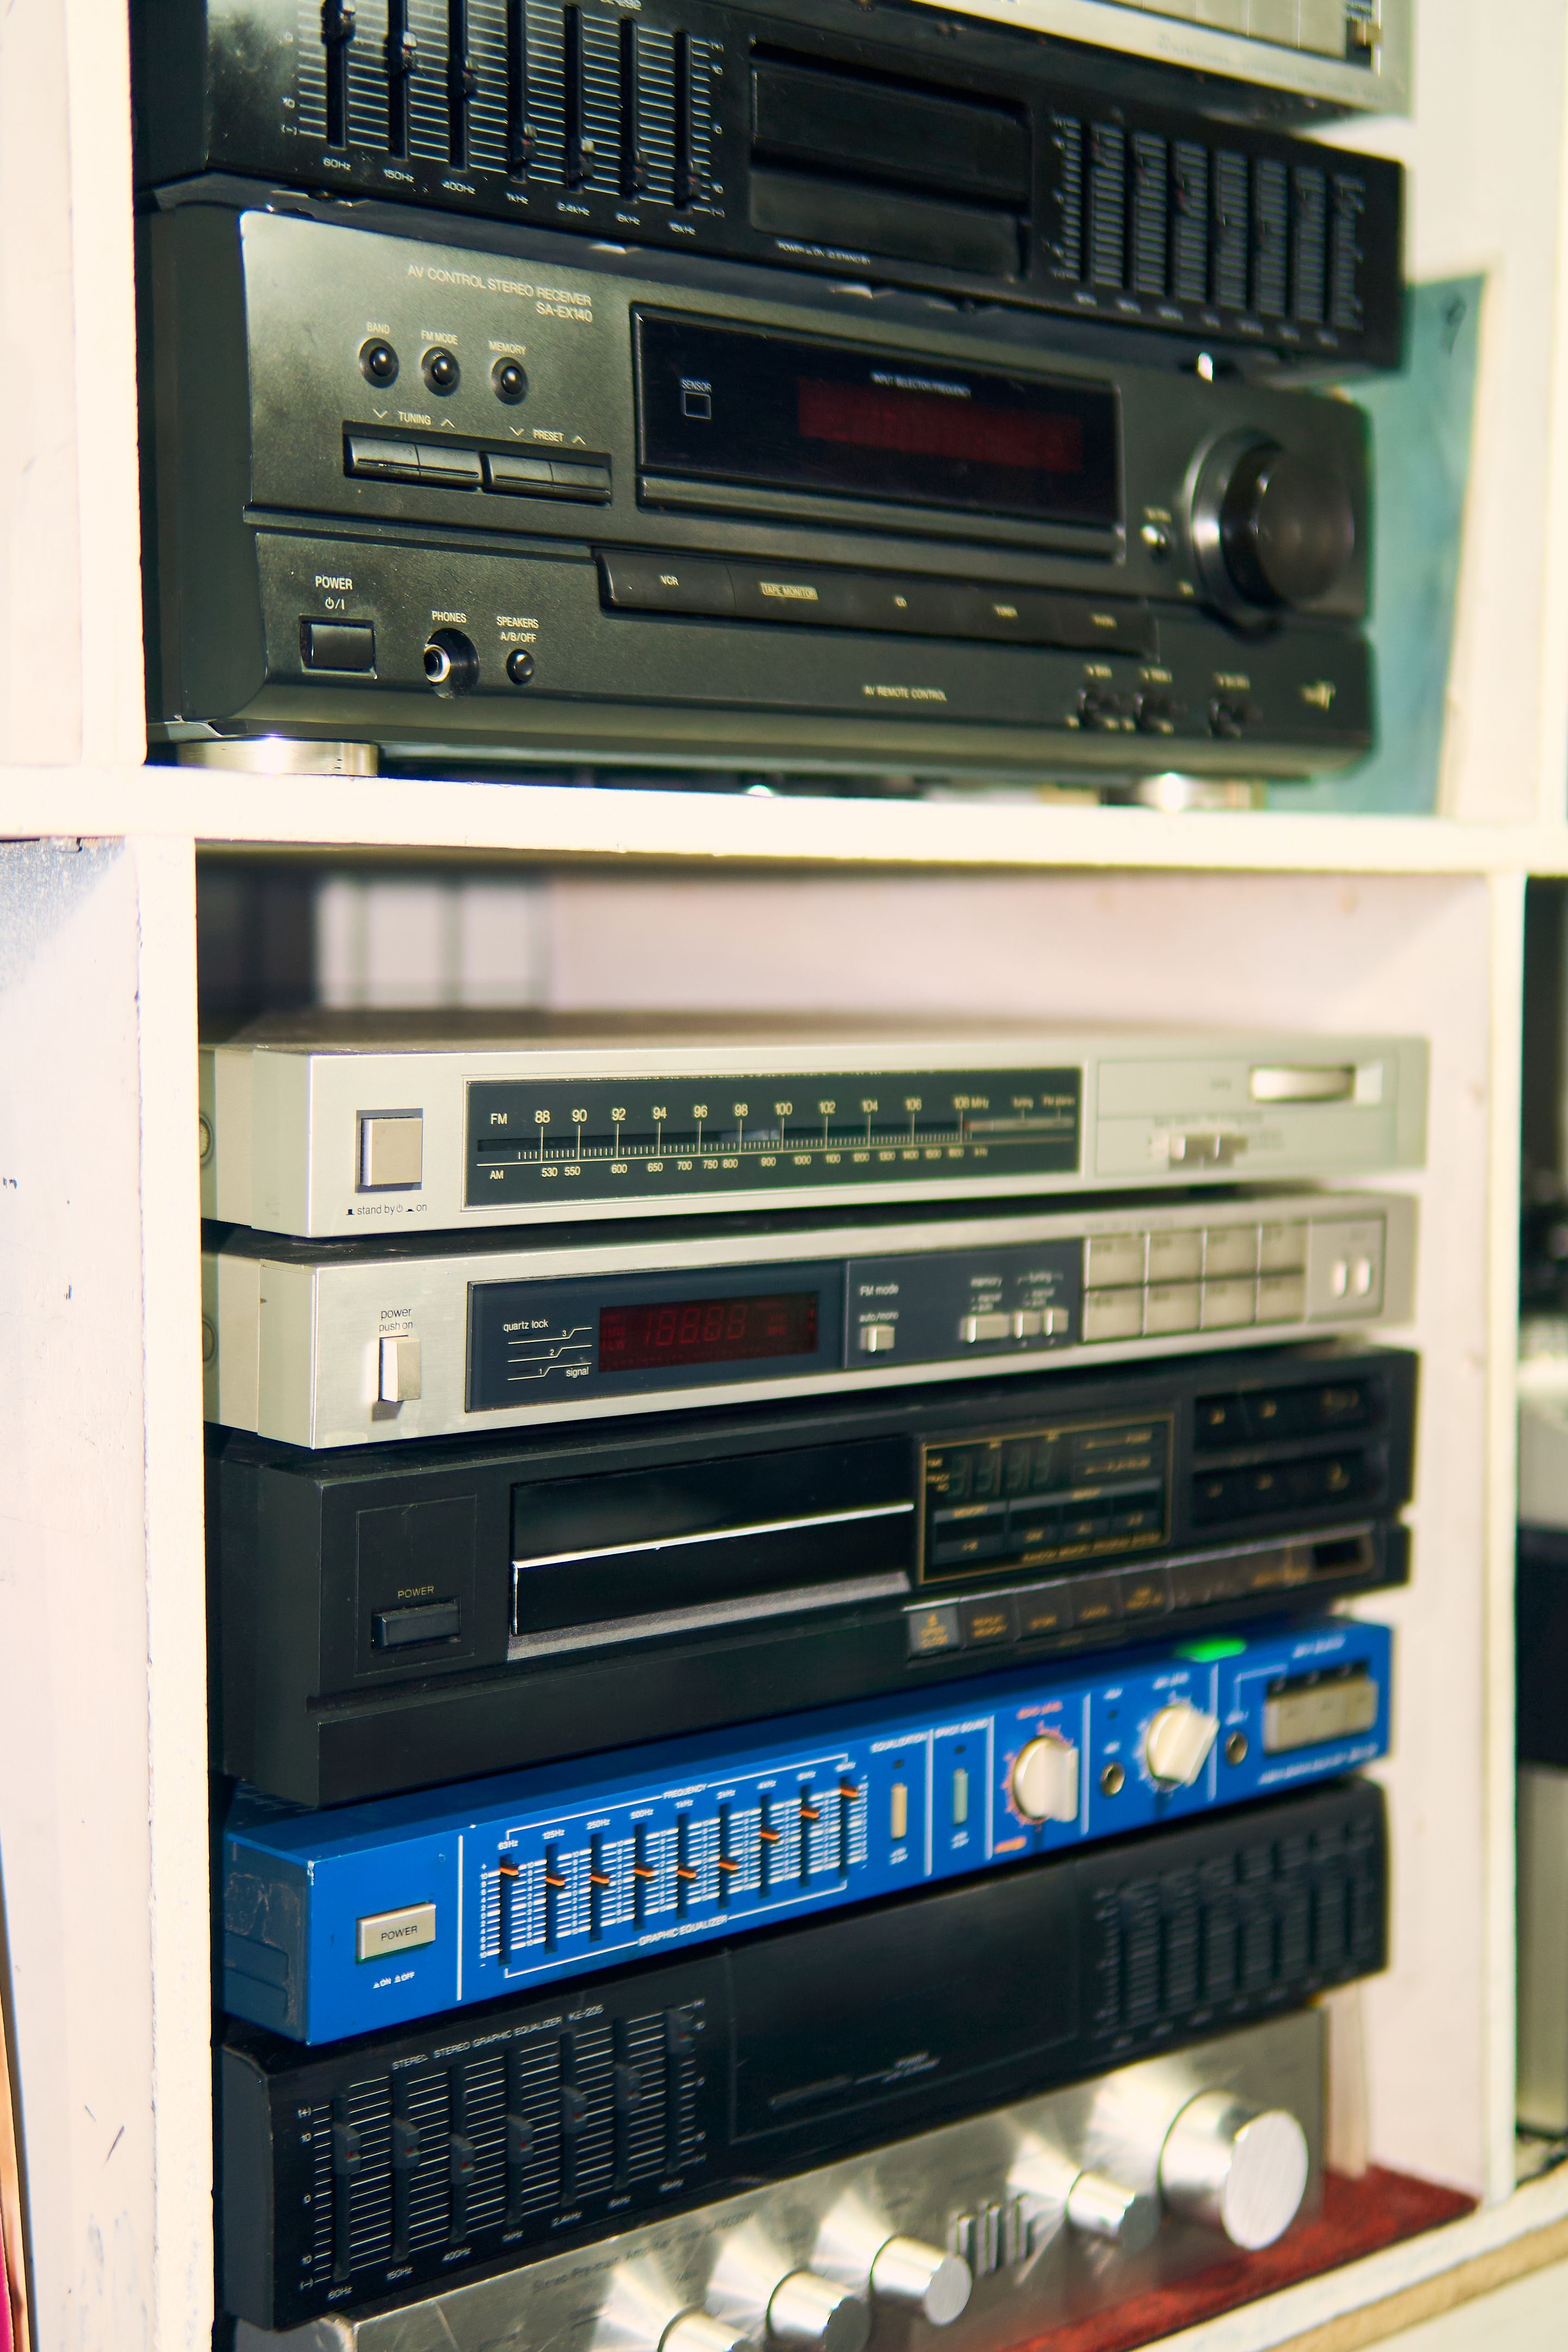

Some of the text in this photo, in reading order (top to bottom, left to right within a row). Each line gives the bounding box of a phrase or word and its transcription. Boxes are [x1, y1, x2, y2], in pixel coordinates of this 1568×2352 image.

[384, 169, 414, 183] 150Hz
[442, 180, 476, 195] 400Hz
[408, 265, 592, 307] AV CONTROL STEREO RECEIVER
[536, 301, 593, 322] SA-EX140
[366, 322, 390, 335] BAND
[421, 330, 458, 345] FM MODE
[488, 340, 526, 355] MEMORY
[680, 377, 713, 394] SENSOR
[398, 411, 431, 426] TUNING
[532, 429, 564, 443] PRESET
[315, 575, 353, 591] POWER
[660, 575, 679, 587] VCR
[432, 610, 467, 624] PHONES
[496, 615, 539, 629] SPEAKERS
[500, 632, 537, 643] A/B/OFF
[491, 1113, 507, 1124] FM
[535, 1110, 550, 1124] 88
[572, 1108, 587, 1123] 90
[611, 1107, 627, 1121] 92
[653, 1106, 667, 1120] 94
[694, 1104, 708, 1118] 96
[734, 1104, 748, 1117] 98
[775, 1102, 793, 1116] 100
[819, 1102, 836, 1115] 102
[862, 1100, 878, 1113] 104
[905, 1099, 922, 1112] 106
[490, 1170, 504, 1180] AM
[542, 1167, 558, 1178] 530
[565, 1166, 581, 1177] 550
[611, 1164, 627, 1174] 600
[647, 1162, 663, 1173] 650
[677, 1160, 693, 1171] 700
[703, 1159, 718, 1169] 750
[722, 1158, 738, 1168] 800
[761, 1156, 776, 1167] 900
[794, 1155, 811, 1165] 1000
[357, 1204, 427, 1217] stand by on
[860, 1284, 899, 1296] FM mode
[381, 1308, 412, 1320] power
[378, 1321, 413, 1333] push on
[503, 1319, 549, 1333] quartz lock
[562, 1330, 567, 1338] 3
[566, 1367, 589, 1378] signal
[397, 1585, 434, 1599] POWER
[662, 1784, 707, 1799] FREQUENCY
[498, 1840, 518, 1850] 63Hz
[542, 1829, 565, 1840] 125Hz
[587, 1819, 610, 1829] 250Hz
[381, 1926, 418, 1940] POWER
[638, 1928, 678, 1946] GRAPHIC
[434, 2041, 470, 2058] STEREO
[473, 2030, 513, 2048] GRAPHIC
[513, 2016, 562, 2036] EQUALIZER
[300, 2132, 312, 2142] 10
[303, 2194, 311, 2204] 0
[301, 2255, 313, 2265] 10
[328, 2286, 353, 2300] 60Hz
[386, 2266, 414, 2280] 150Hz
[443, 2247, 472, 2262] 400Hz
